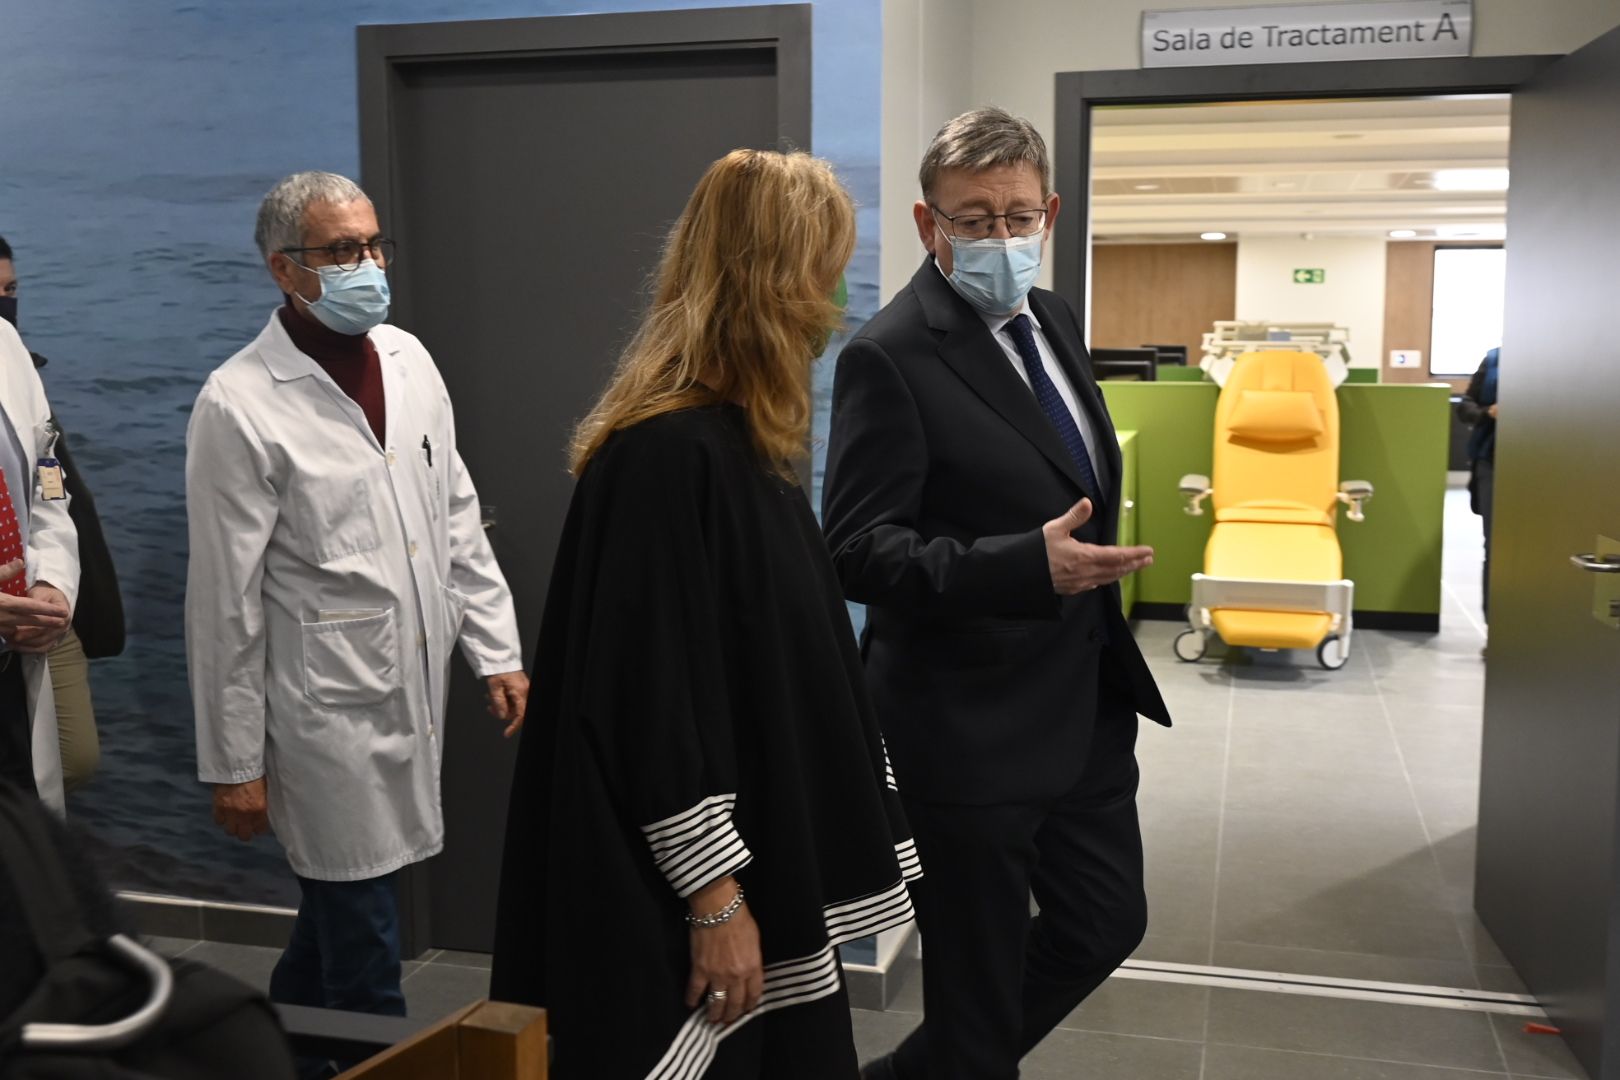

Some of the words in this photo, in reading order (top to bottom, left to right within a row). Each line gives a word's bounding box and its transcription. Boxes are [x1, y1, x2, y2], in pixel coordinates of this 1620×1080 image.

[1152, 29, 1211, 52] Sala
[1220, 27, 1253, 49] de
[1262, 21, 1425, 47] Tractament
[1432, 12, 1459, 42] A
